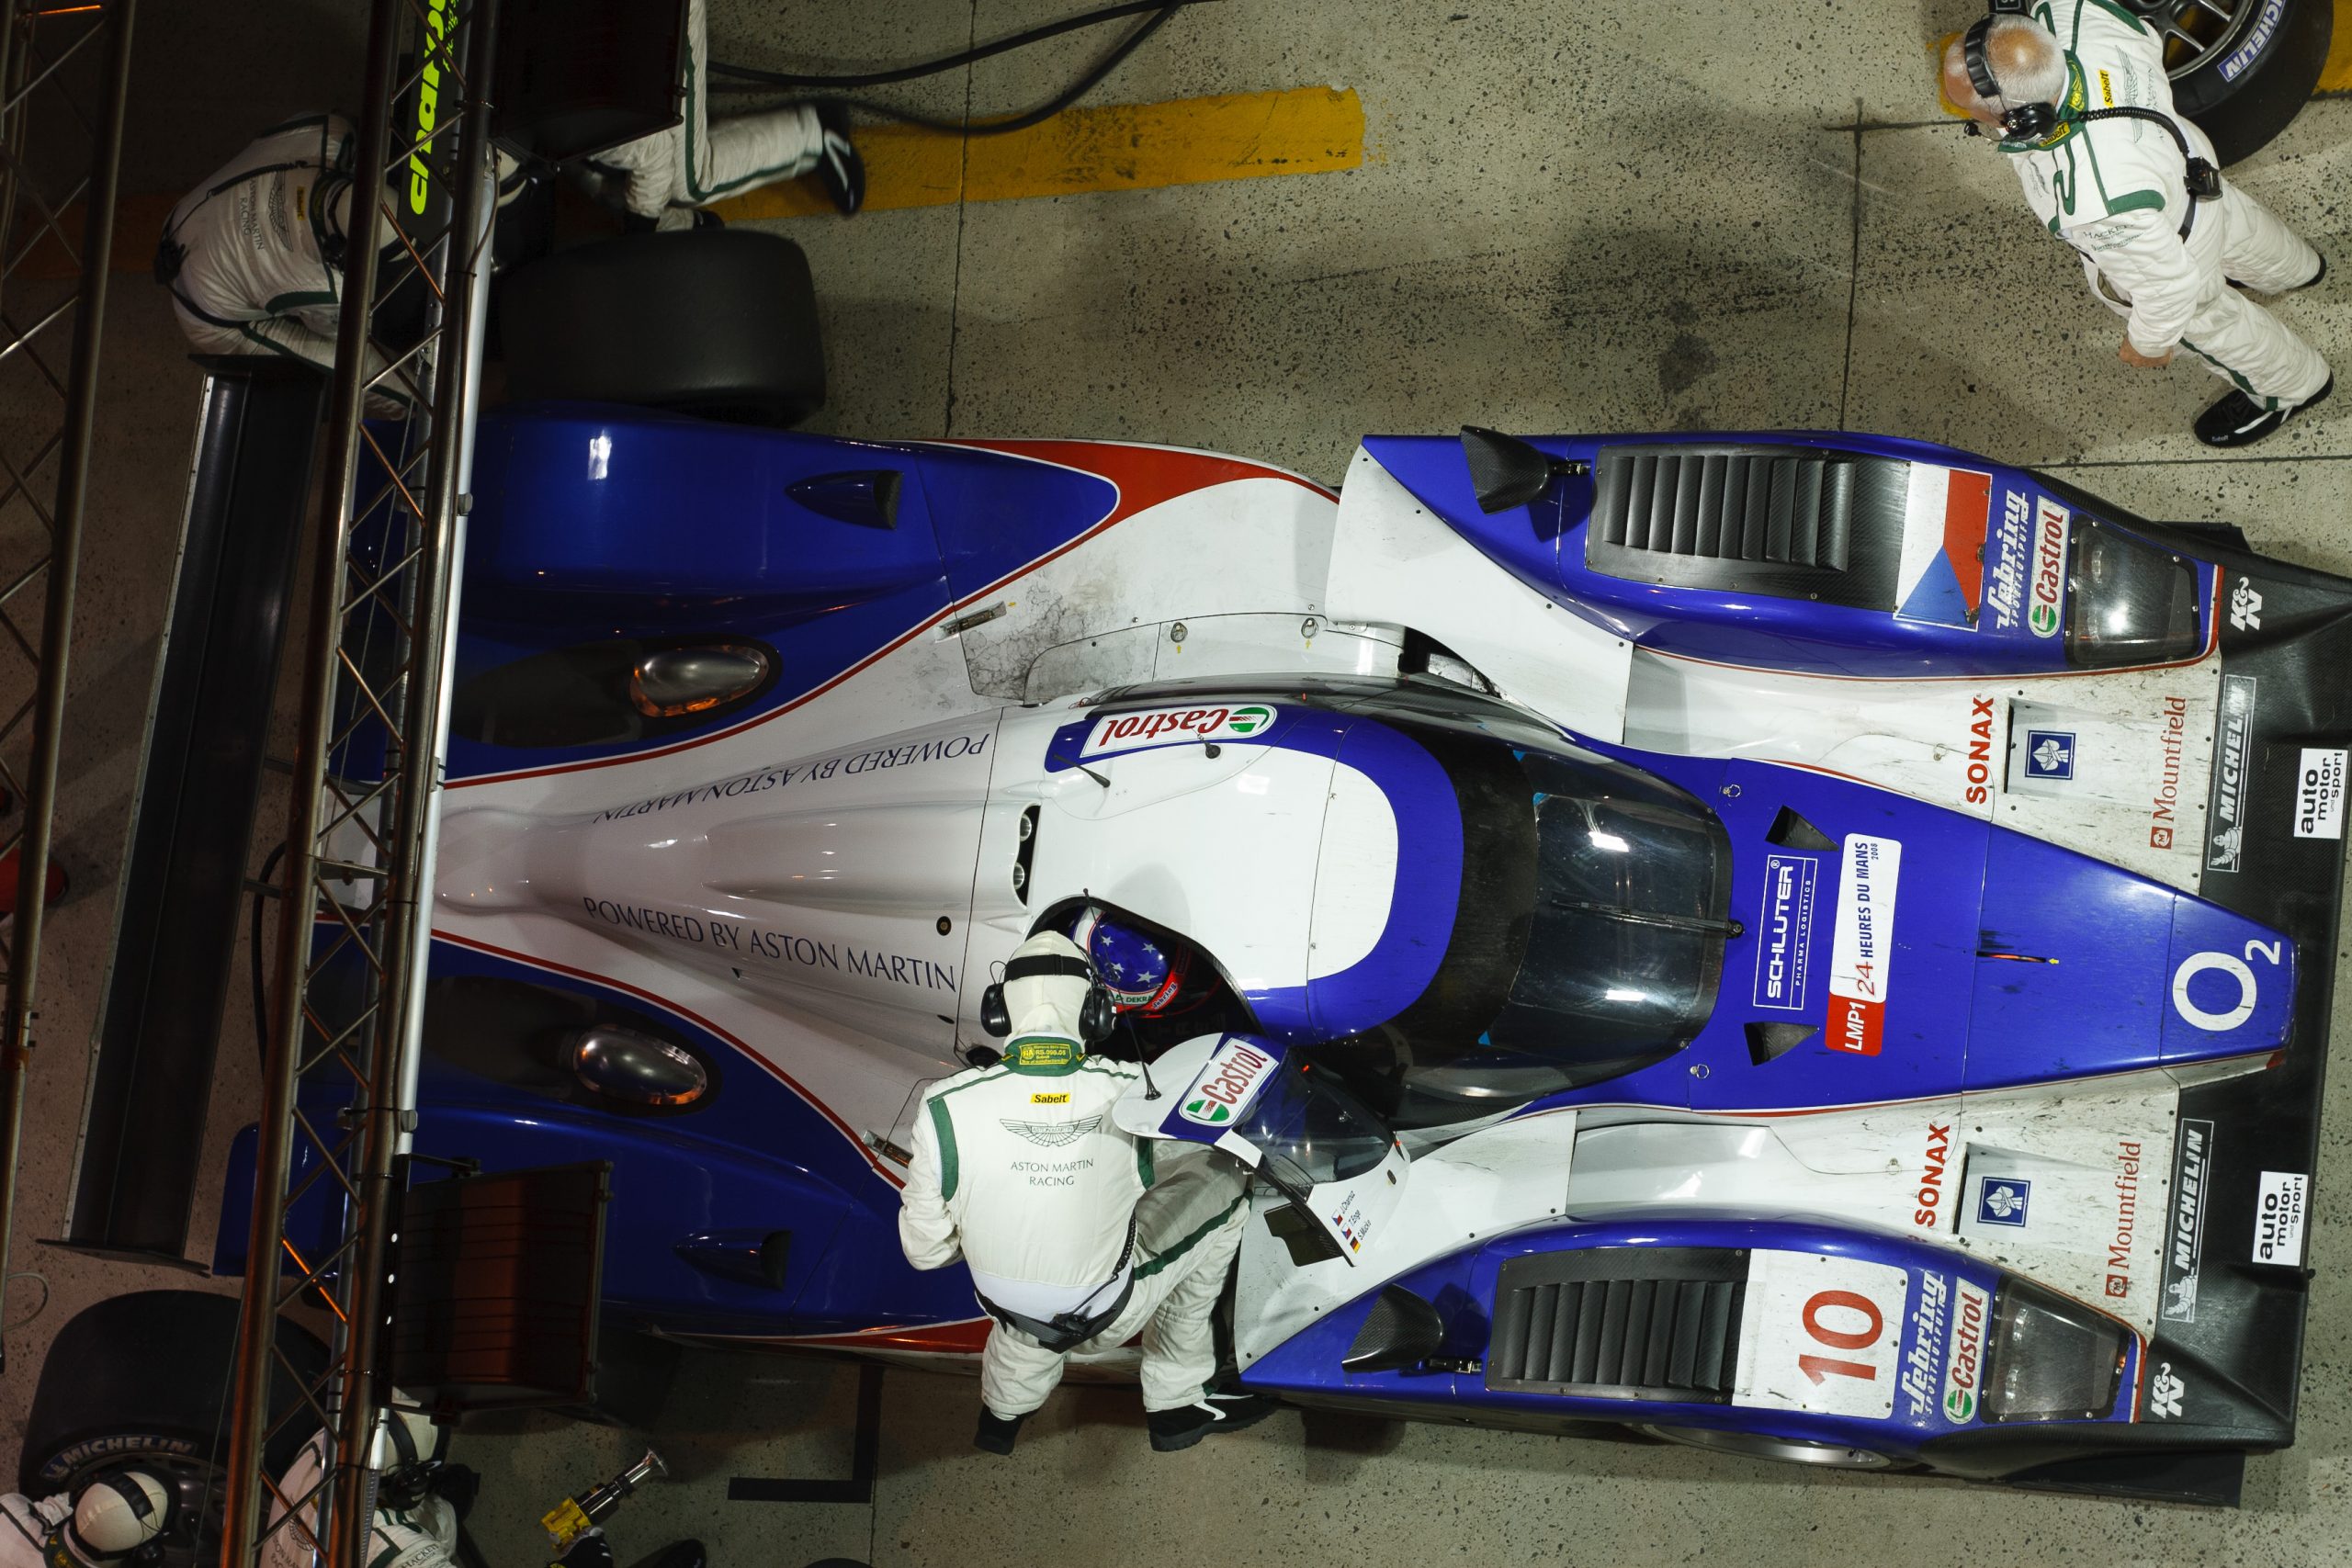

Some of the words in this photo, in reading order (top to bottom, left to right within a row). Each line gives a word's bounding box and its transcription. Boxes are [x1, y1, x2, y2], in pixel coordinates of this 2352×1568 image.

[411, 0, 446, 214] charo
[2100, 72, 2113, 104] Sabelt
[240, 197, 252, 236] RACING
[2035, 509, 2064, 604] Castrol
[845, 733, 989, 773] POWERED
[1098, 708, 1229, 748] Castrol
[1965, 696, 1994, 805] SONAX
[2220, 685, 2245, 822] MICHELIN
[802, 758, 837, 784] BY
[2153, 696, 2186, 822] Mountfield
[2331, 752, 2343, 798] sport
[593, 788, 703, 824] MARTIN
[702, 766, 803, 804] ASTON
[2301, 769, 2318, 834] auto
[2317, 757, 2331, 820] motor
[1854, 841, 1869, 880] MANS
[1871, 842, 1879, 861] 2008
[1857, 883, 1871, 903] DU
[582, 896, 704, 943] POWERED
[711, 921, 741, 951] BY
[750, 929, 839, 971] ASTON
[846, 946, 956, 993] MARTIN
[1795, 949, 1805, 986] PHARMA
[1800, 879, 1812, 937] LOGISTICS
[1858, 906, 1873, 959] HEURES
[1857, 961, 1875, 997] 24
[1844, 1001, 1867, 1051] LMP1
[1035, 1094, 1068, 1103] Sabelt
[1201, 1044, 1268, 1104] Castrol
[1011, 1161, 1048, 1172] ASTON
[1053, 1158, 1093, 1172] MARTIN
[1029, 1175, 1074, 1187] RACING
[1915, 1122, 1951, 1228] SONAX
[2108, 1141, 2142, 1270] Mountfield
[2175, 1128, 2203, 1270] MICHELIN
[2277, 1181, 2290, 1247] motor
[2290, 1177, 2302, 1224] sport
[2259, 1193, 2278, 1260] auto
[1798, 1290, 1883, 1386] 10
[1951, 1292, 1983, 1389] Castrol
[62, 1437, 191, 1464] MICHELIN
